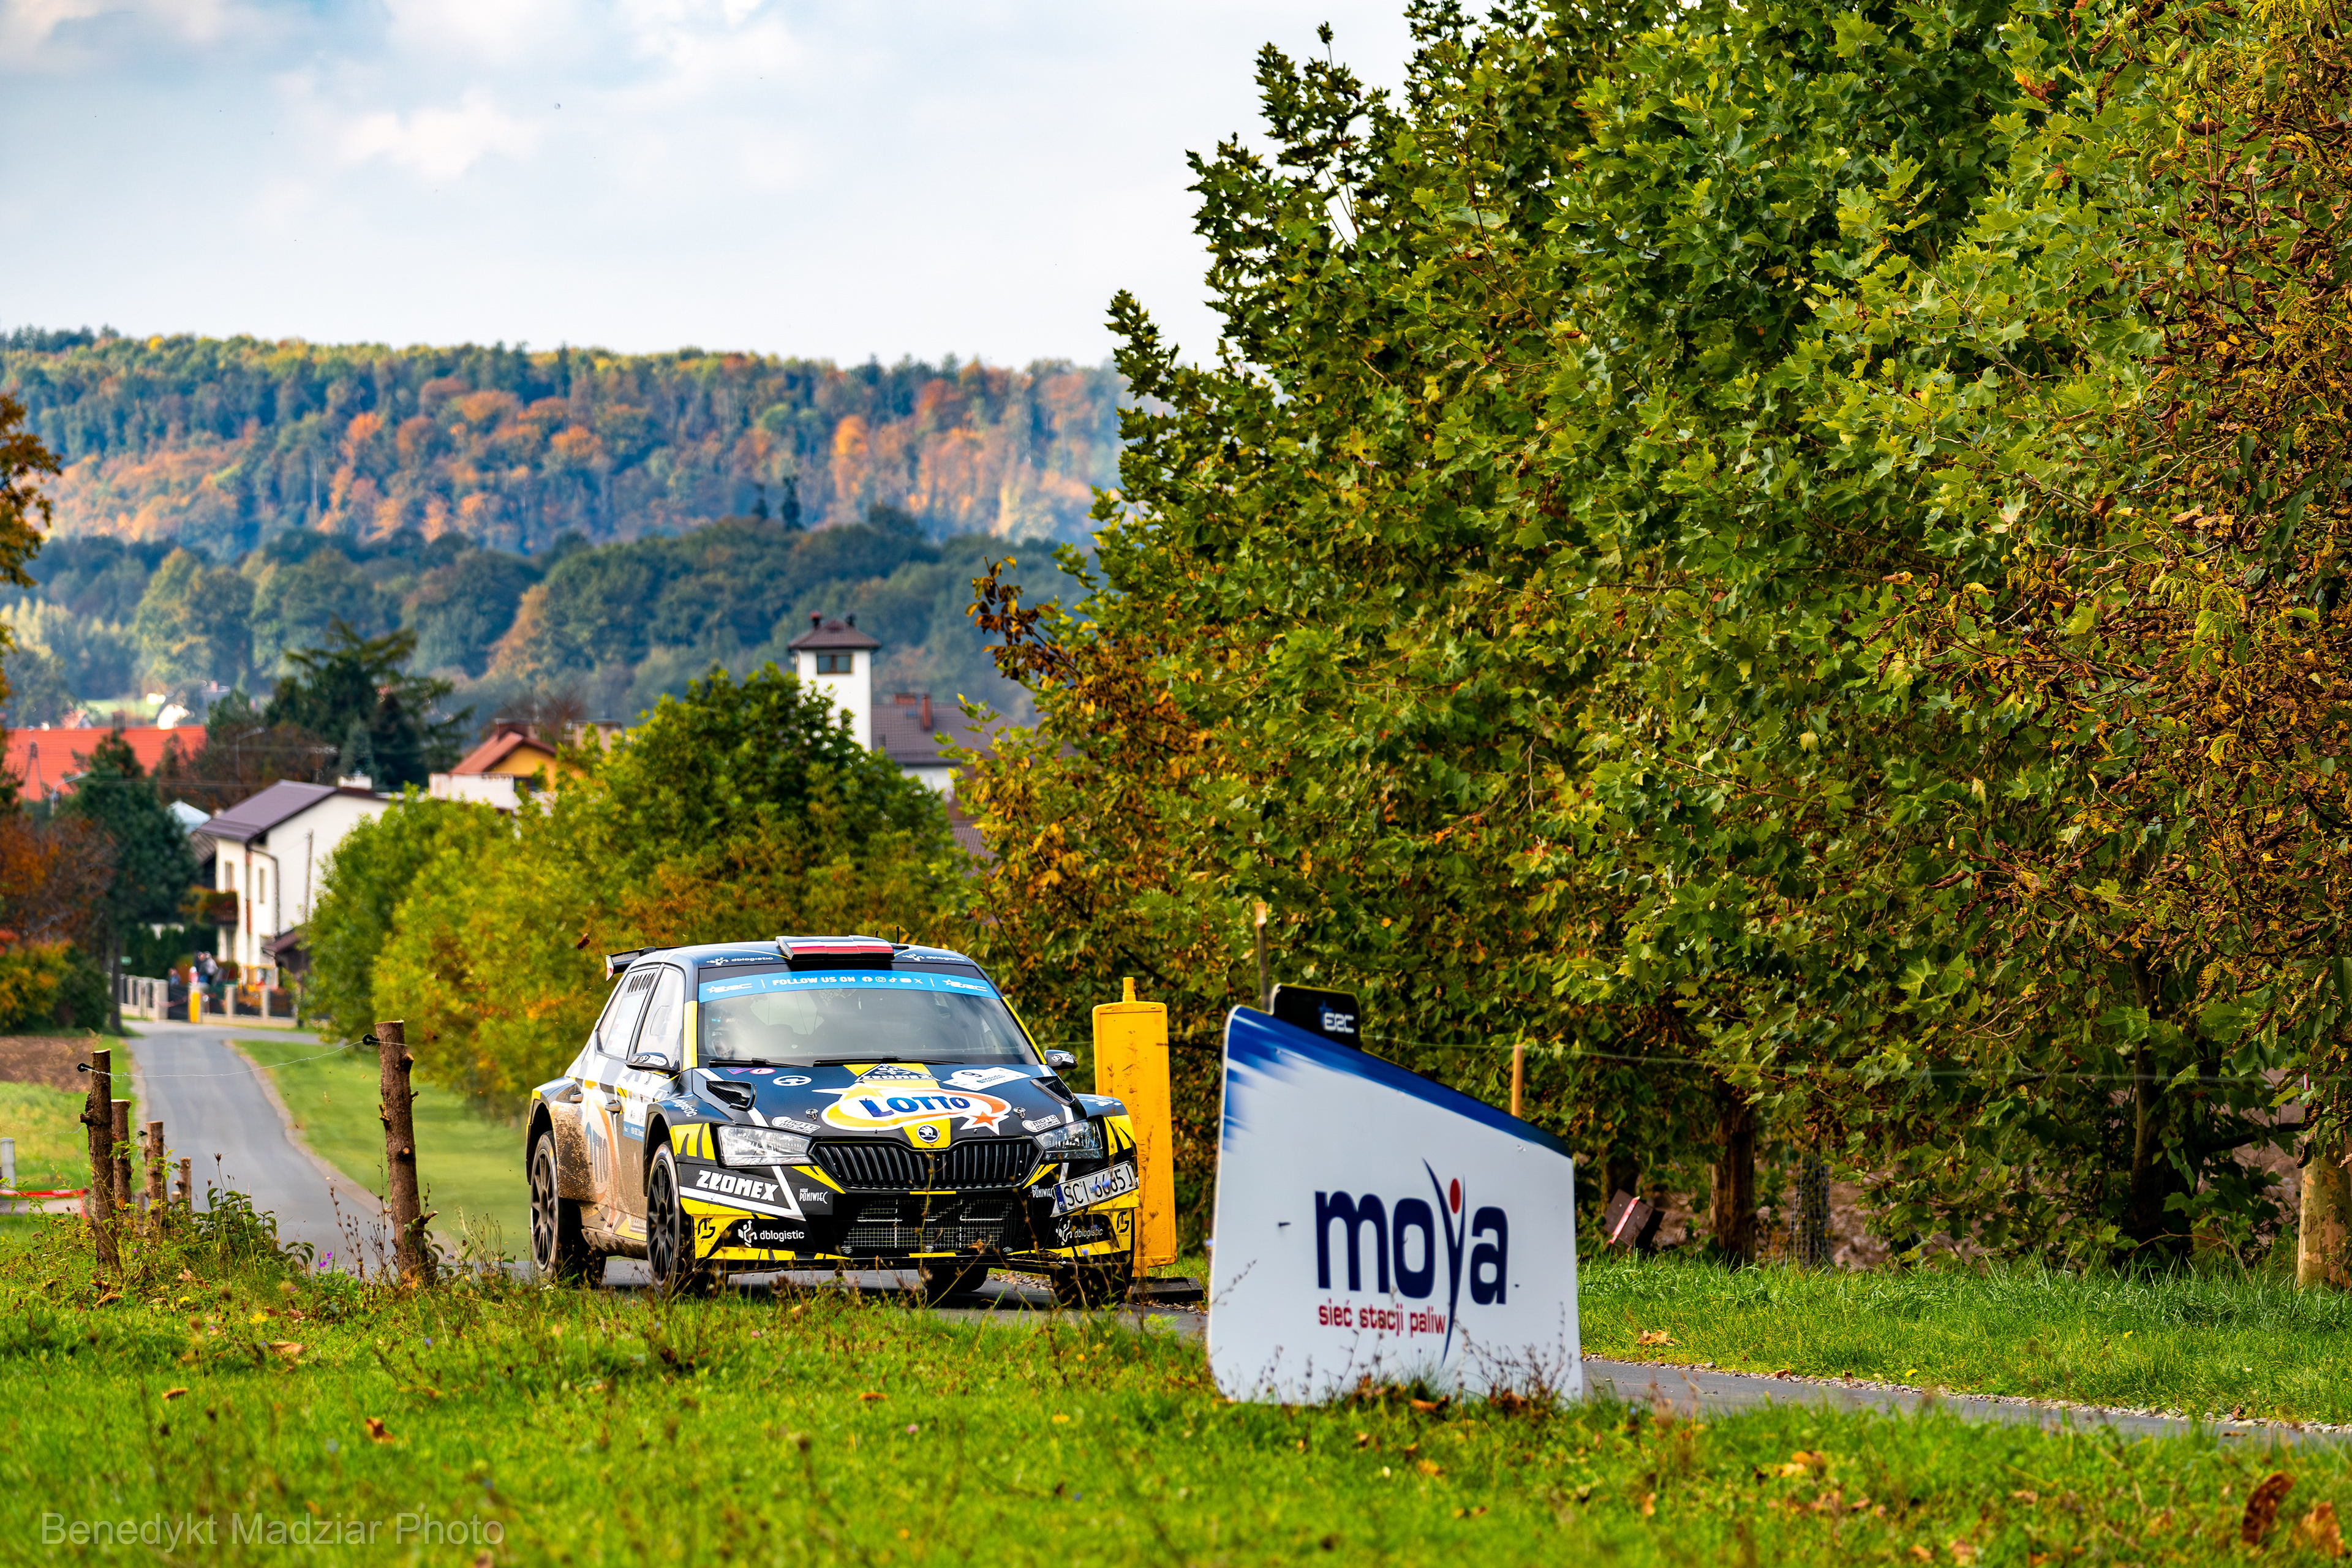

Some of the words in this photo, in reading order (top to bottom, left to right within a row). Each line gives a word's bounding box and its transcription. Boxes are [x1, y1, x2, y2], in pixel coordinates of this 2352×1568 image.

[772, 978, 818, 986] FOLLOW
[1324, 1012, 1355, 1034] ERC
[859, 1095, 971, 1118] LOTTO
[696, 1169, 780, 1202] ZŁOMEX
[760, 1229, 805, 1242] dblogistic
[1074, 1227, 1103, 1240] dblogistic
[1318, 1297, 1353, 1328] sieć
[1359, 1303, 1404, 1338] stacji
[1410, 1305, 1446, 1339] paliw
